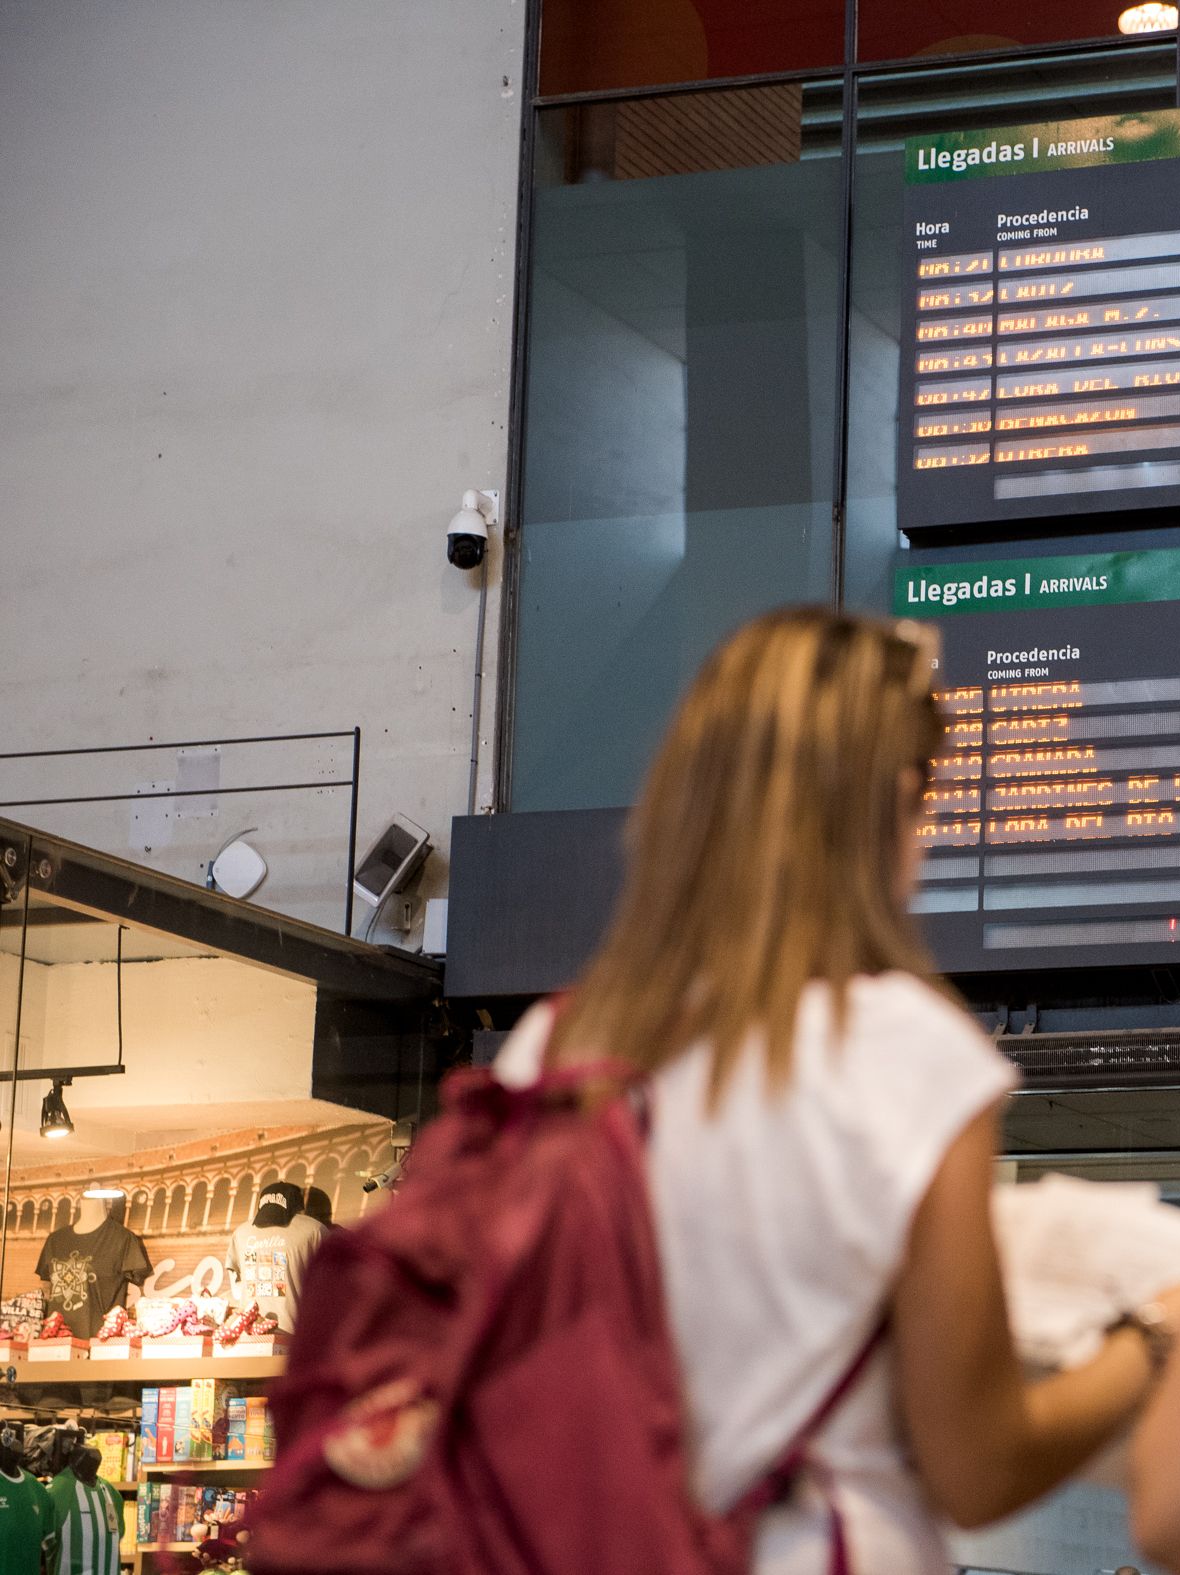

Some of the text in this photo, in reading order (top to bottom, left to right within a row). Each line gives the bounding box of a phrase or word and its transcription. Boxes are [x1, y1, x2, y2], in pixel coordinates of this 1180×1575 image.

[918, 137, 1114, 172] Llegadas ARRIVALS
[997, 206, 1089, 228] Procedencia
[915, 221, 950, 236] Hora
[997, 226, 1058, 241] COMING FROM
[916, 239, 937, 249] TIME
[907, 576, 1108, 605] Llegadas ARRIVALS
[986, 644, 1080, 665] Procedencia
[987, 666, 1049, 680] COMING FROM
